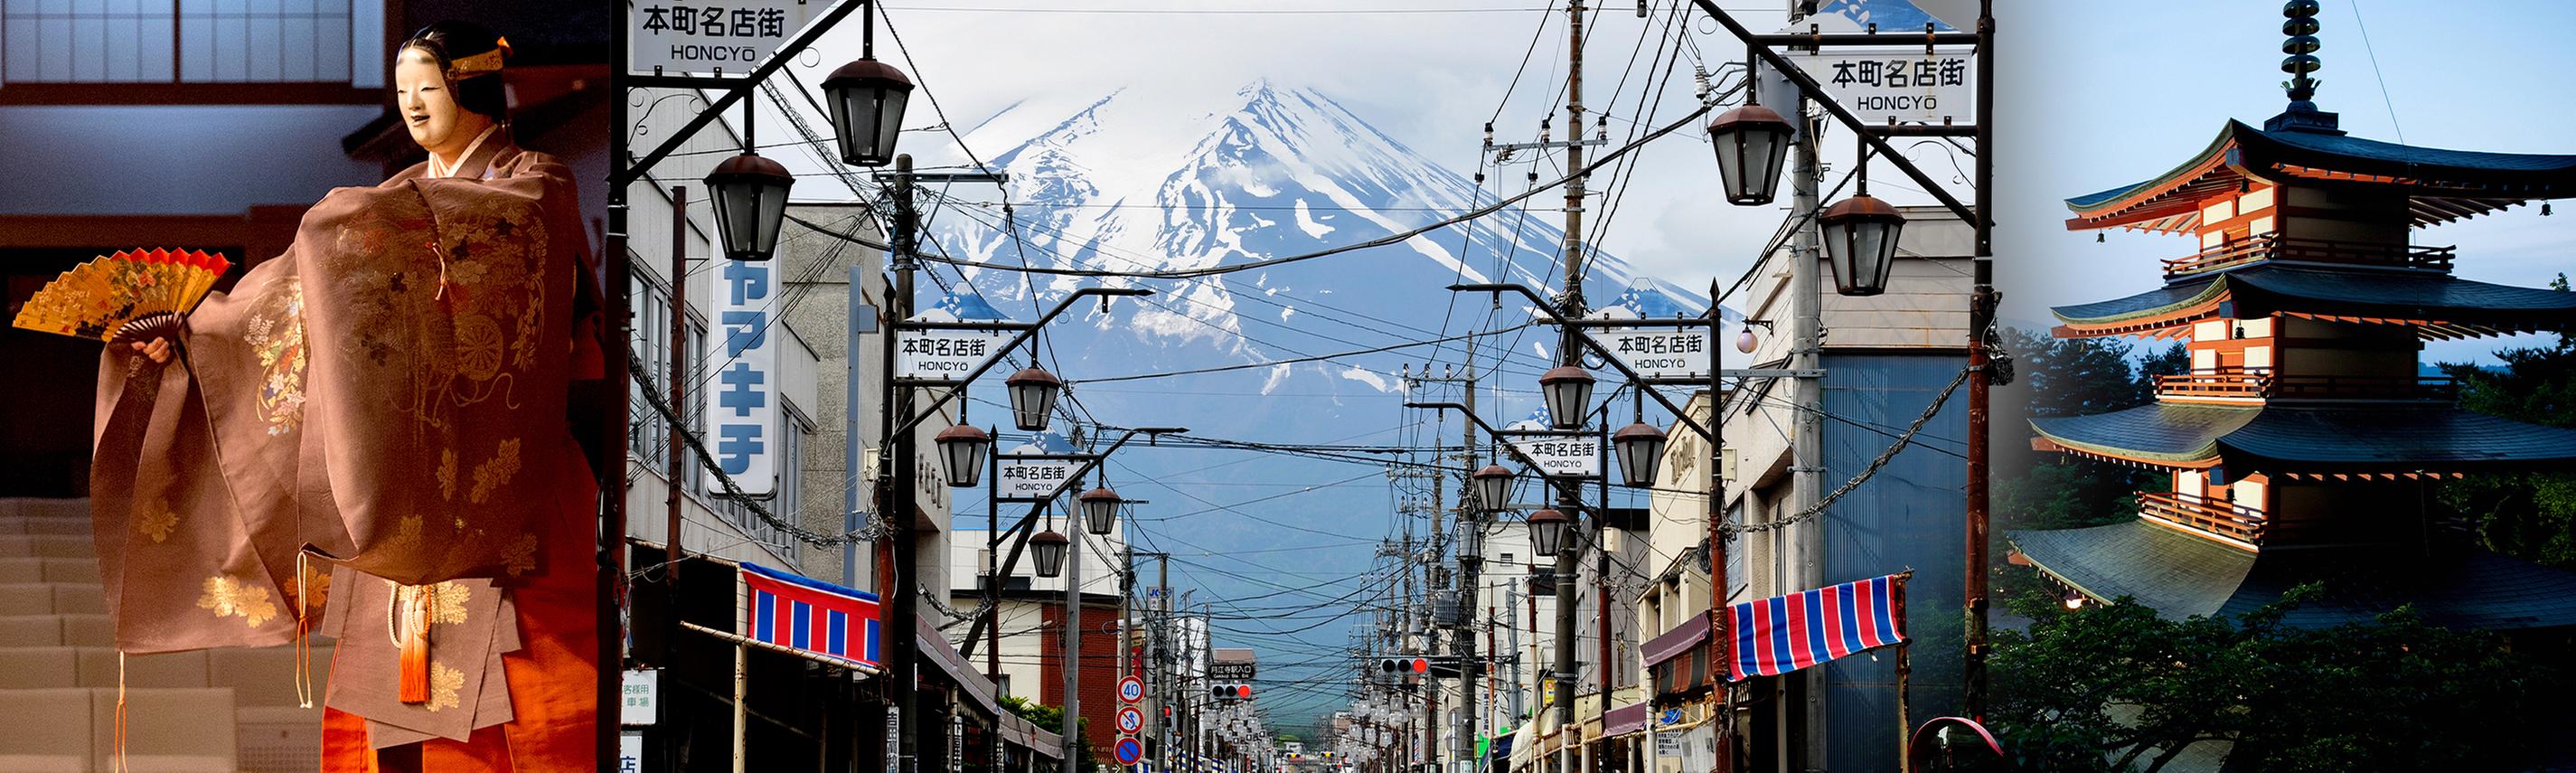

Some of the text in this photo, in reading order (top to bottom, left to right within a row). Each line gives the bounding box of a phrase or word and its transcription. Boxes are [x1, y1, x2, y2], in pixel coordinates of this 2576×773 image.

[643, 5, 785, 38] 本町名店街
[671, 45, 756, 61] HONCYŌ
[1831, 58, 1965, 89] 本町名店街
[1857, 95, 1937, 110] HONCYŌ
[902, 338, 986, 357] 本町名店街
[1618, 335, 1702, 354] 本町名店街
[1531, 443, 1594, 457] 本町名店街
[1003, 467, 1066, 480] 本町名店街
[1123, 683, 1140, 697] 40
